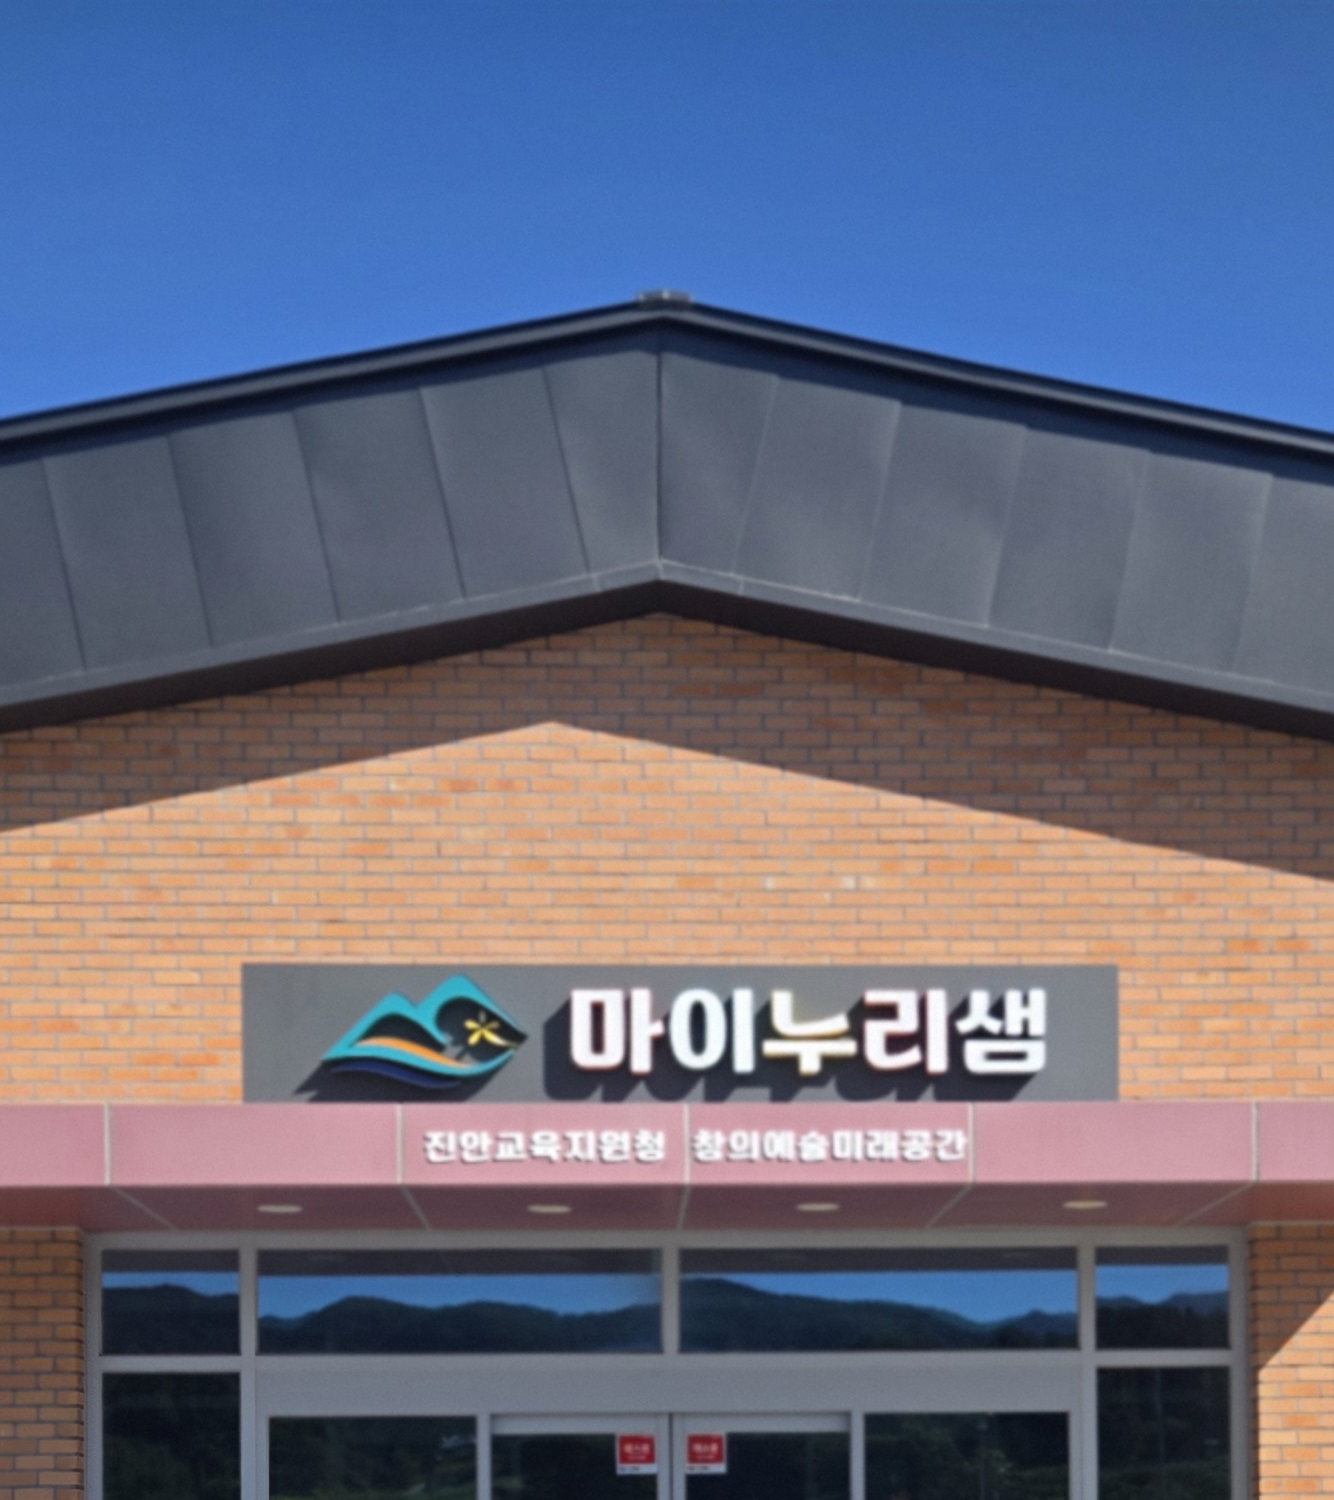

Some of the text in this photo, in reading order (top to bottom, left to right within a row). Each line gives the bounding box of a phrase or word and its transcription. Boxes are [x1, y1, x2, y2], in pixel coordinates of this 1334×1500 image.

[570, 986, 1047, 1075] 마이누리샘
[423, 1129, 967, 1164] 진안교육지원청 창의예술미래공간
